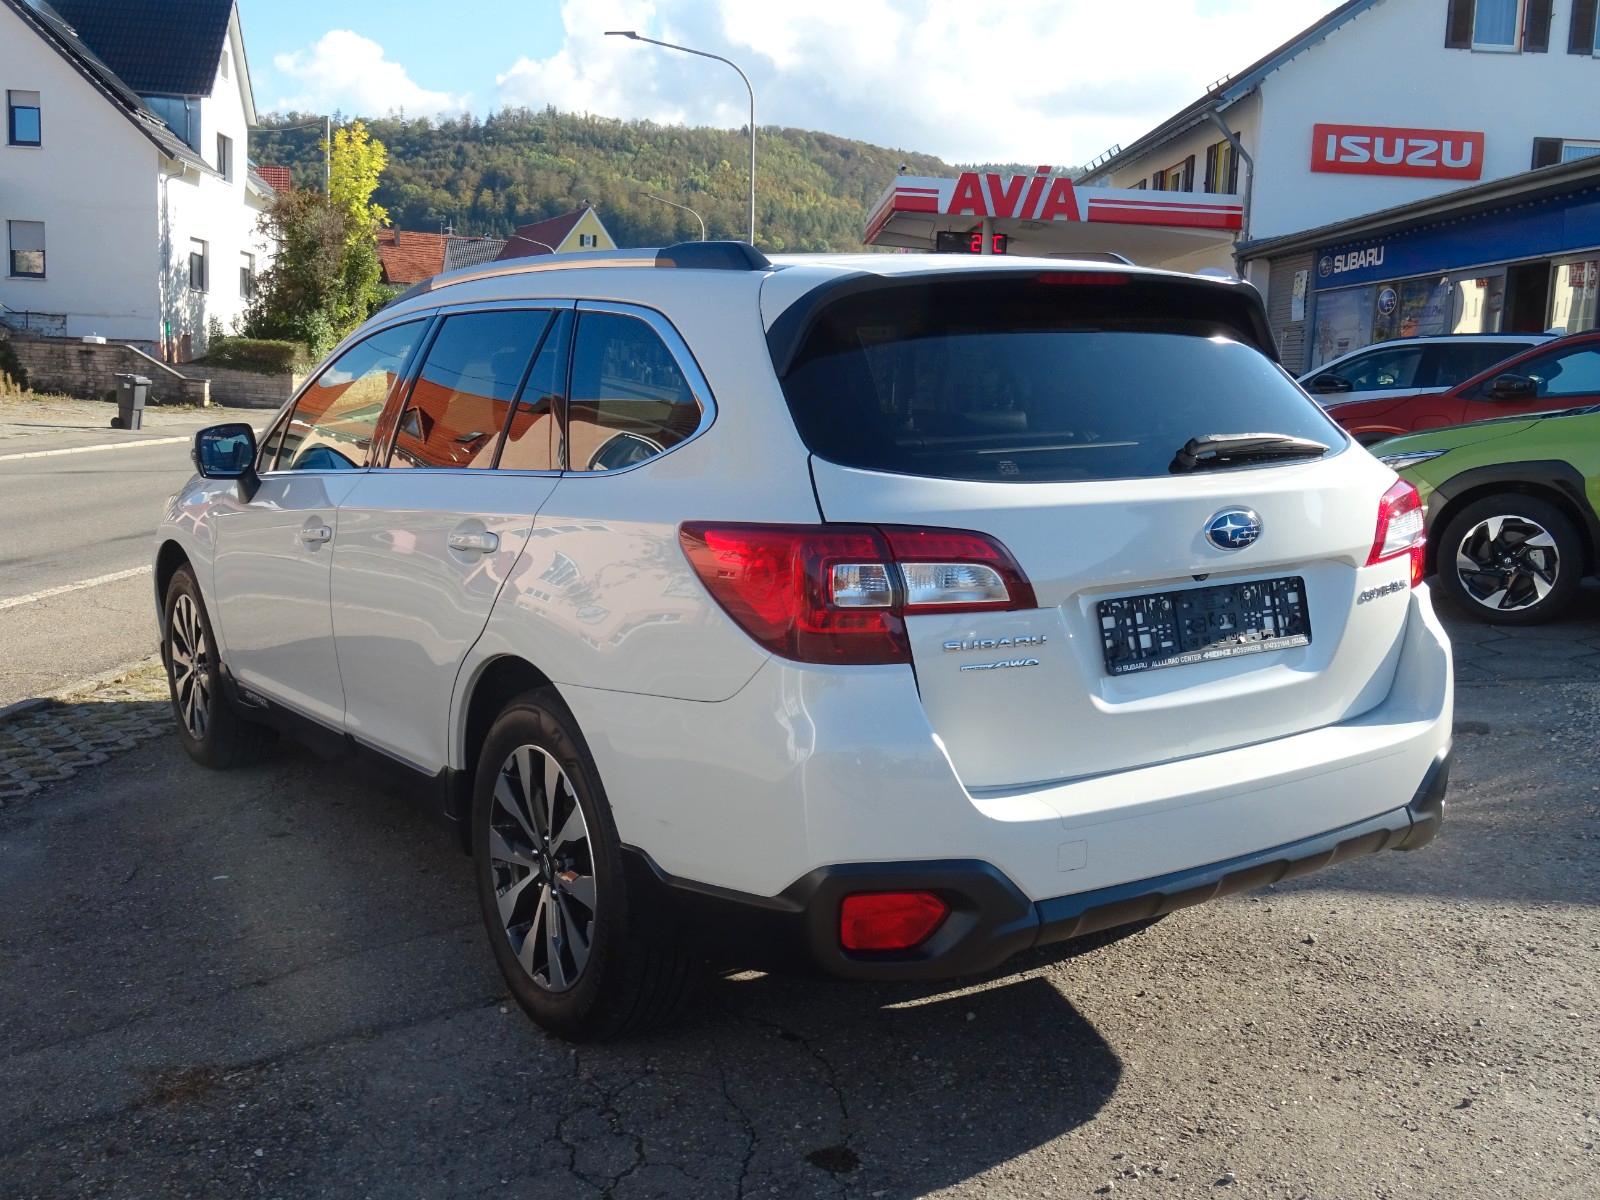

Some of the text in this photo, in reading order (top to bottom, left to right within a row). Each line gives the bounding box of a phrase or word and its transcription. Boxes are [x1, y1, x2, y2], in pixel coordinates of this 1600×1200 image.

[1326, 135, 1472, 167] ISUZU
[1334, 246, 1384, 273] SUBARU
[943, 634, 1047, 651] SUBARU
[1122, 661, 1148, 673] SUBARU
[1180, 653, 1202, 663] CENTER
